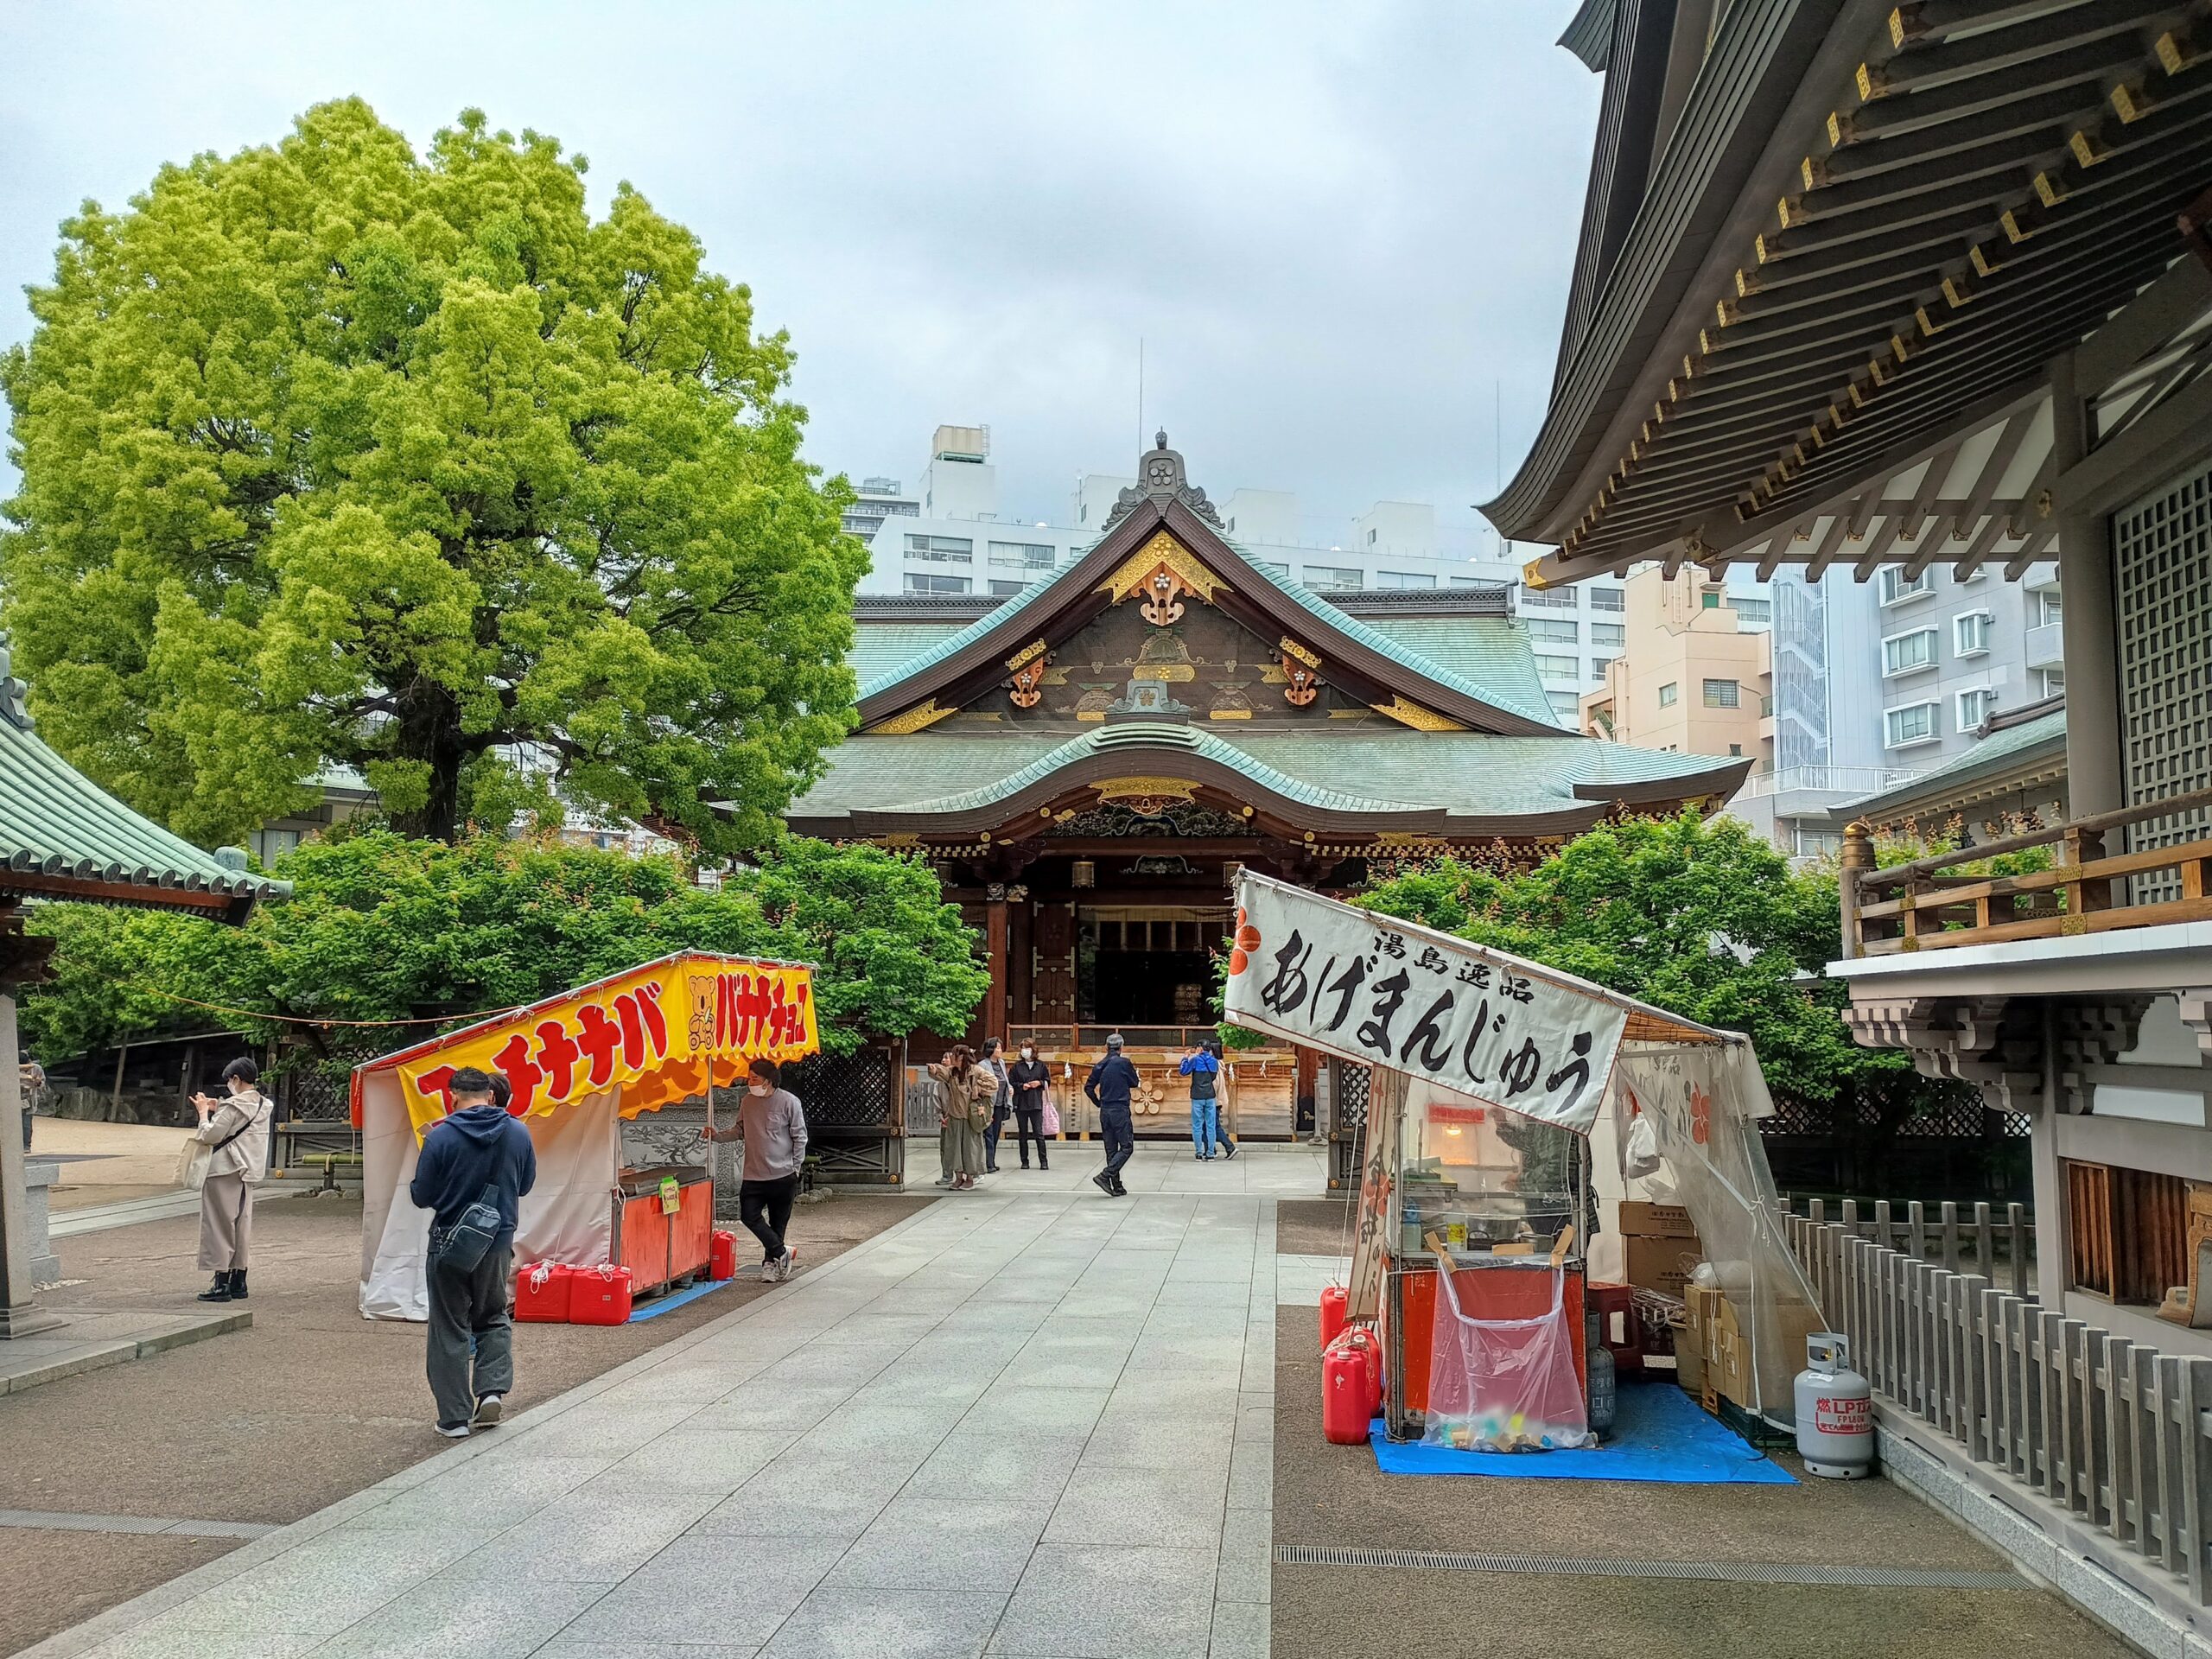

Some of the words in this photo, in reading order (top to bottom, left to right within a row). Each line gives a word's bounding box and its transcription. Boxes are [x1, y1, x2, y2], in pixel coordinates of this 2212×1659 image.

[715, 973, 808, 1049] バナナチョコ
[1261, 929, 1592, 1114] あげまんじゅう
